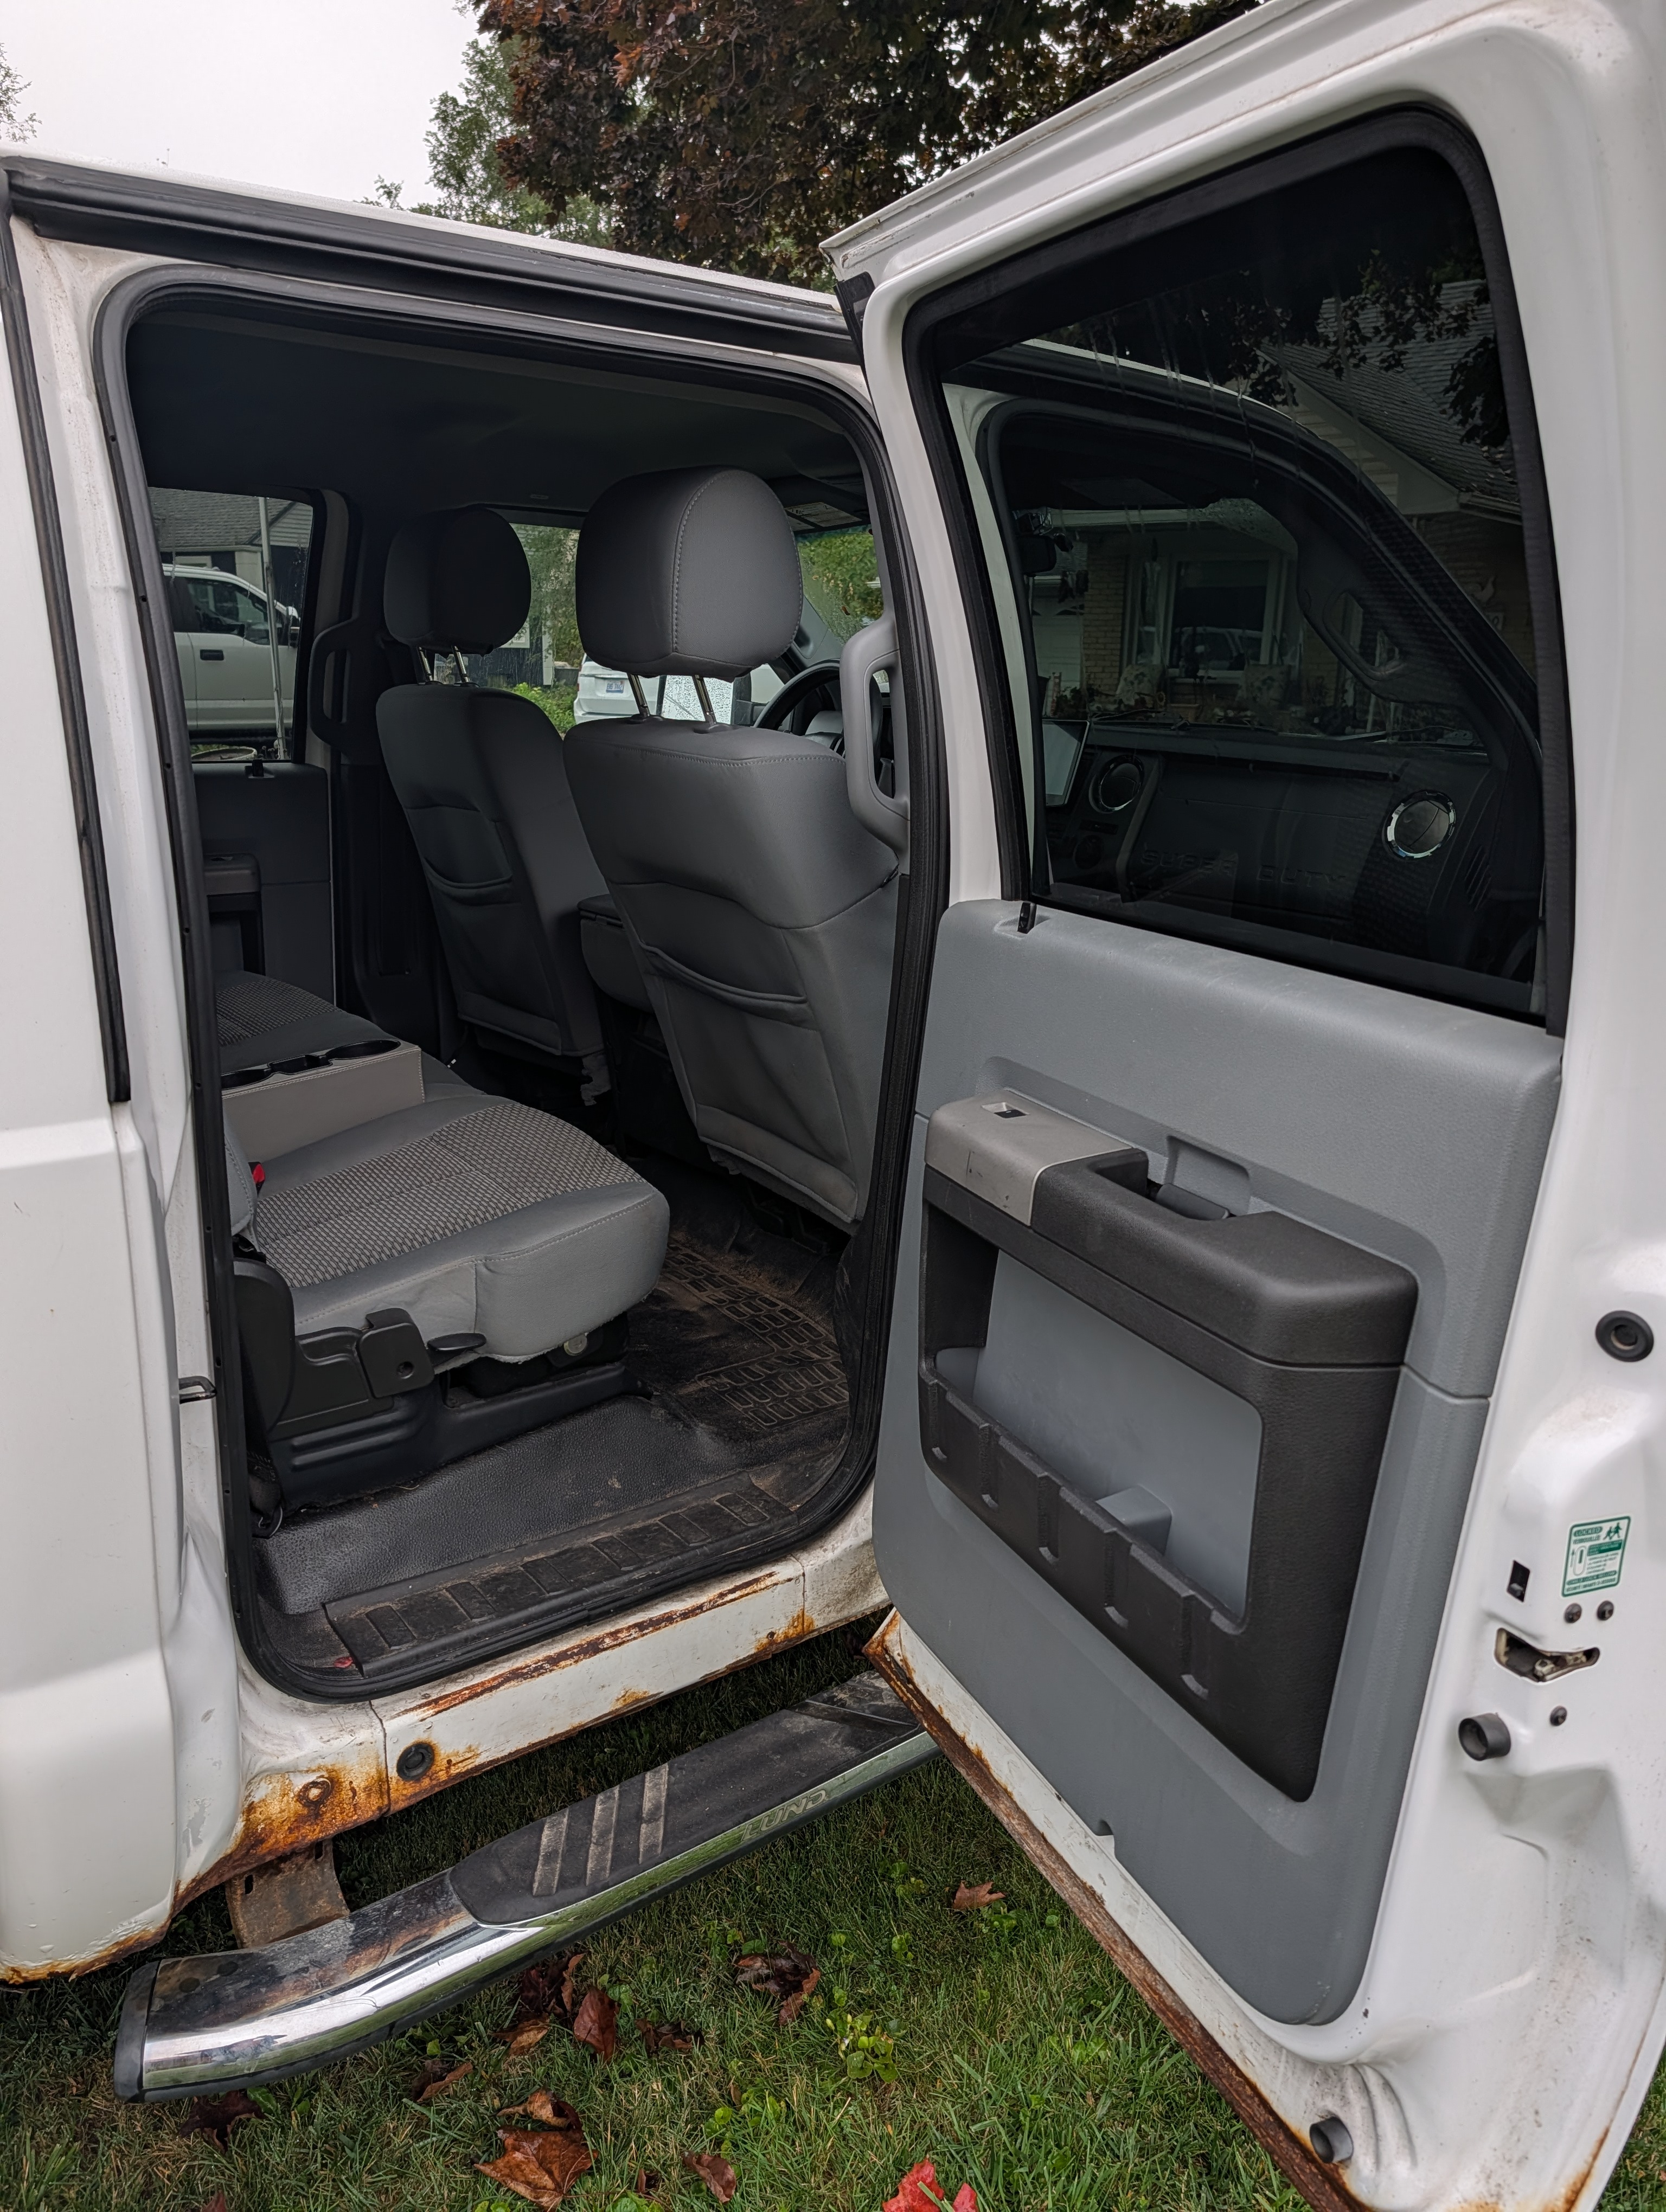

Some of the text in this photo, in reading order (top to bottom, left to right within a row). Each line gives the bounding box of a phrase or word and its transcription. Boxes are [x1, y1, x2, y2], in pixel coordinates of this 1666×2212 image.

[1140, 849, 1347, 890] SUPER DUTY
[741, 1789, 826, 1842] LUND
